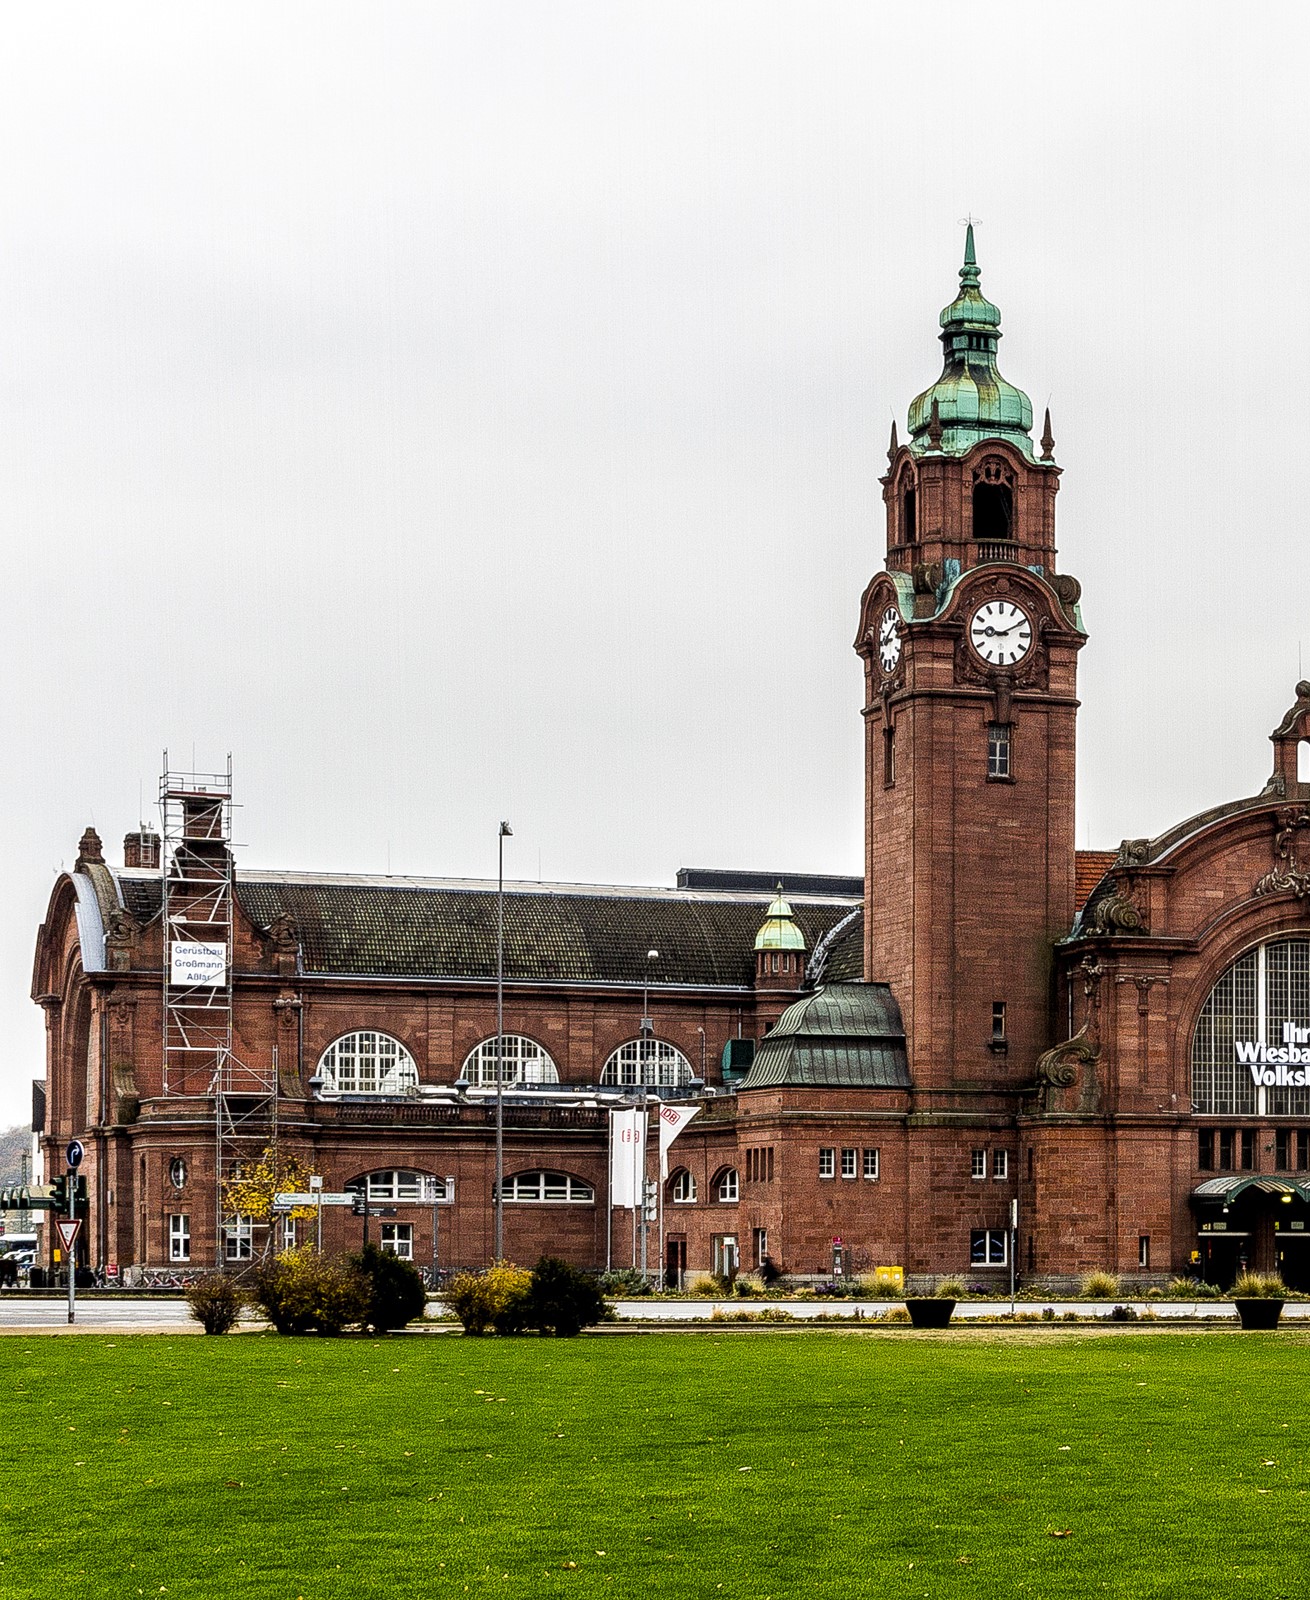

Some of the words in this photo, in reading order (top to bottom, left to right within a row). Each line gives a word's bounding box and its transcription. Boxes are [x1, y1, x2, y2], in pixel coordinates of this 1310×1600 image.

[175, 946, 223, 955] Gerüstbau
[175, 959, 223, 968] Großmann
[662, 1108, 678, 1123] DB
